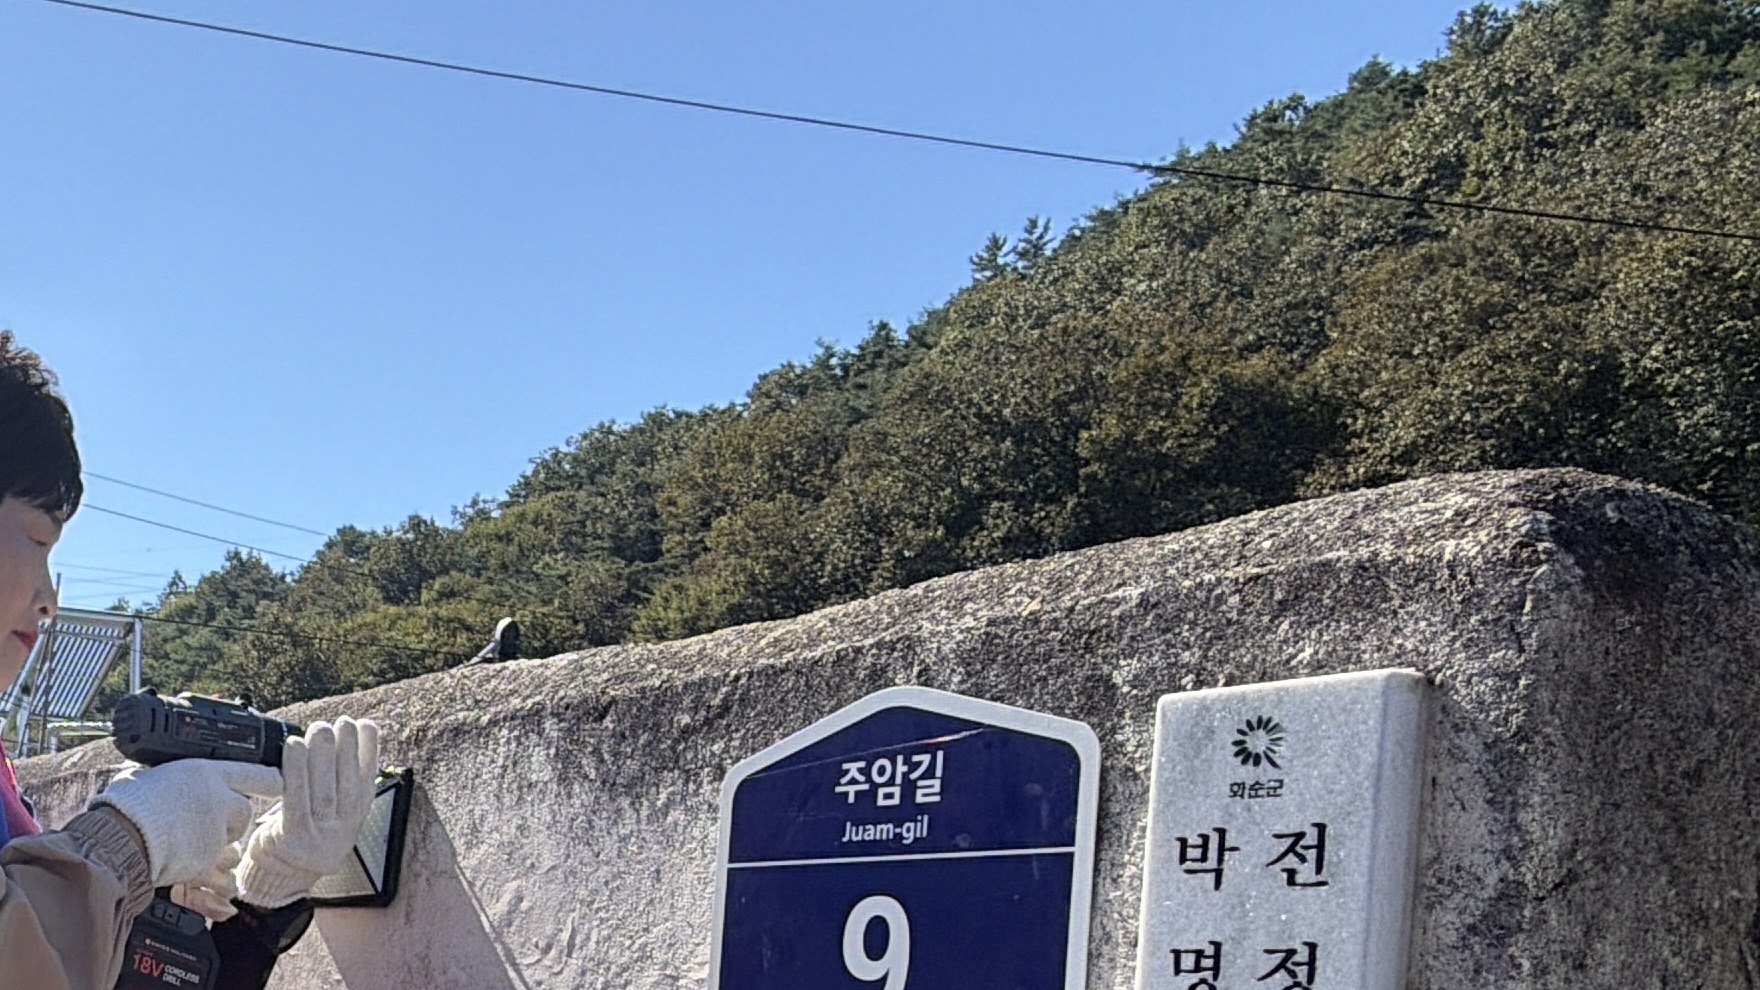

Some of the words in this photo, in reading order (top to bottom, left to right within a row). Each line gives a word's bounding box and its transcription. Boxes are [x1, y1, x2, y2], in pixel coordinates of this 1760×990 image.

[834, 750, 944, 806] 주암길
[842, 815, 929, 844] Juam-gil
[133, 953, 165, 978] 18V
[164, 964, 200, 984] CORDLESS
